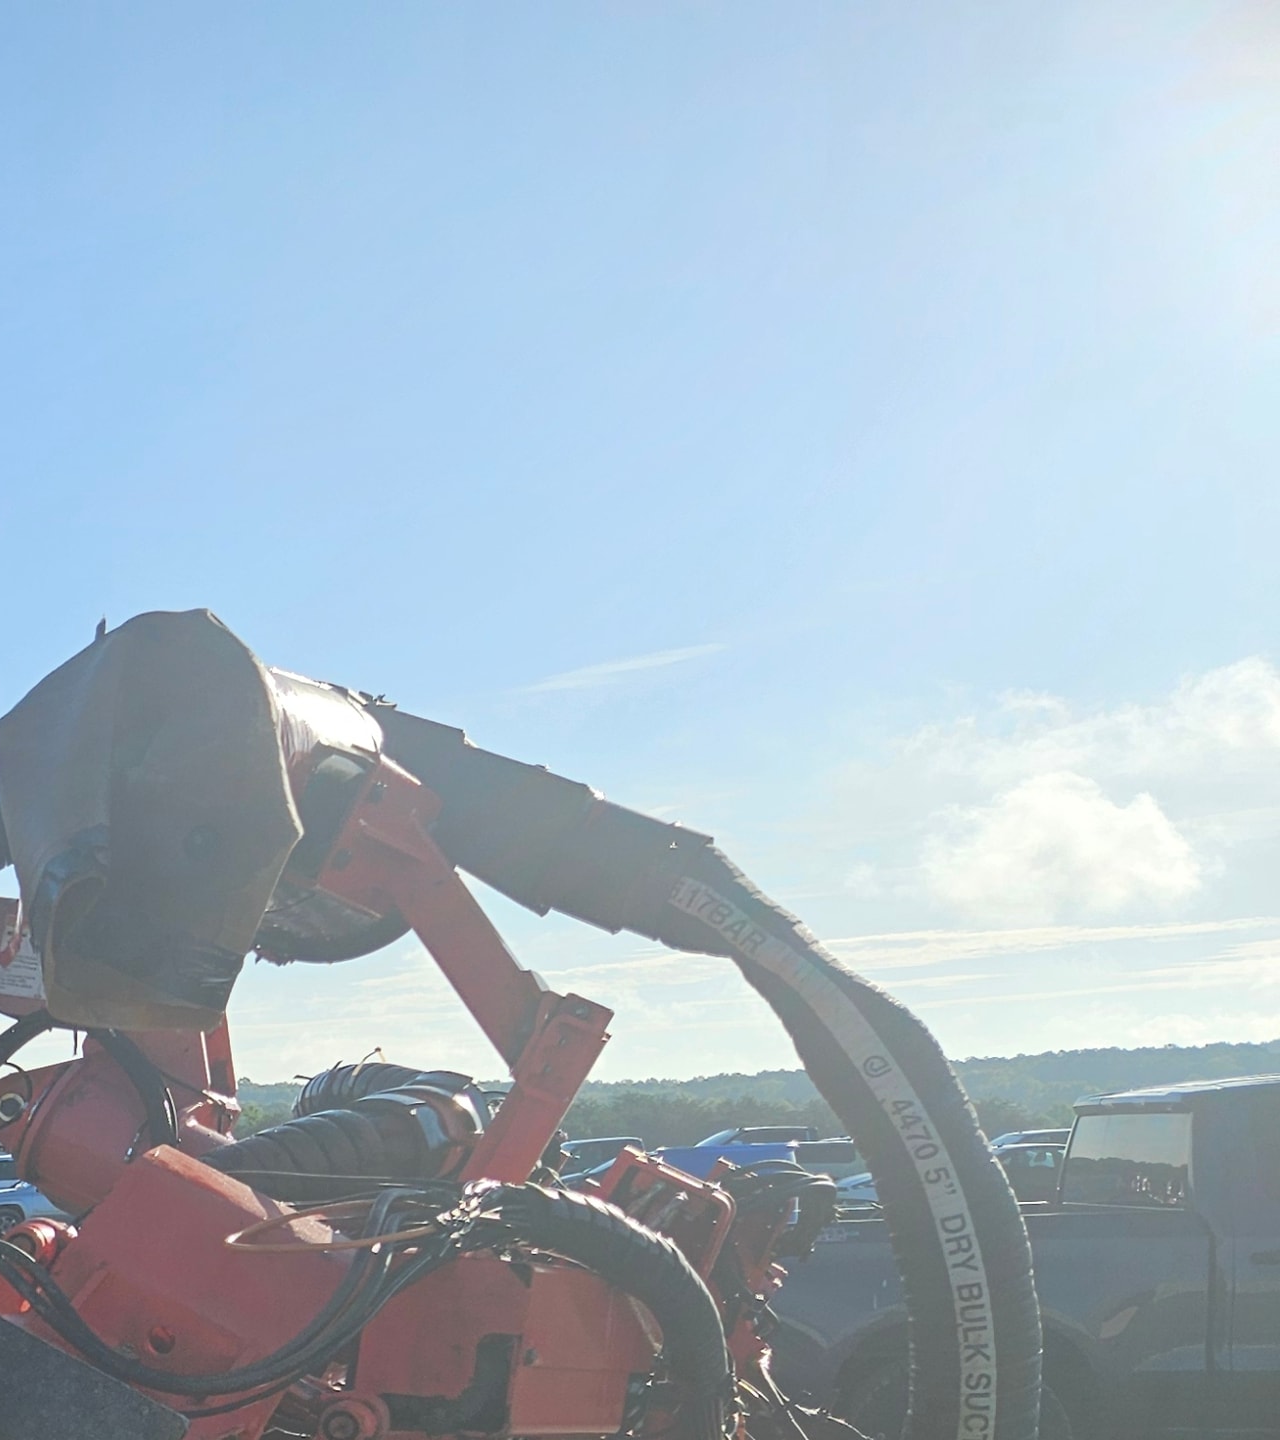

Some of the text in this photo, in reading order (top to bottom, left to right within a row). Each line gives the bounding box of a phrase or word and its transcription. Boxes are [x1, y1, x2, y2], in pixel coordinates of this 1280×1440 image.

[891, 1099, 939, 1161] 4470
[940, 1213, 979, 1273] DRY
[956, 1282, 990, 1363] BULK
